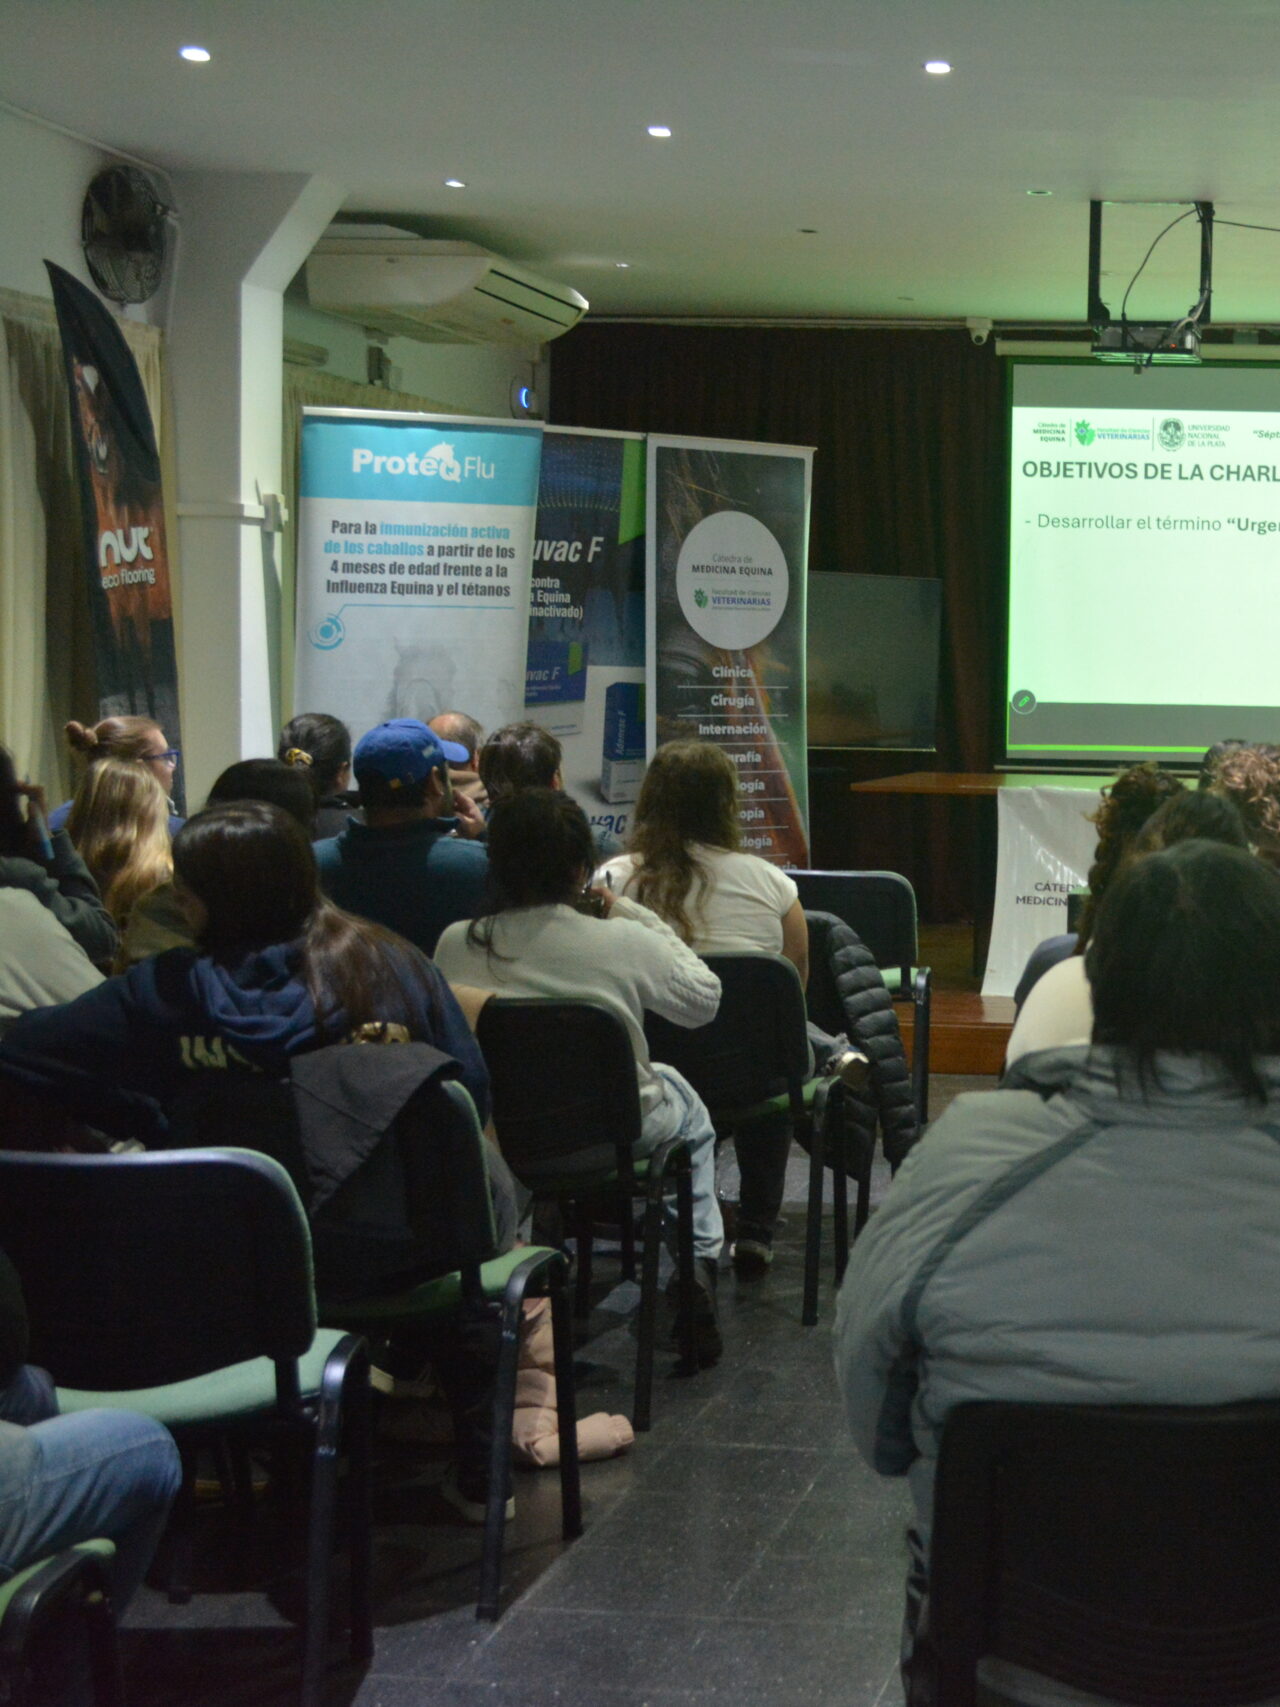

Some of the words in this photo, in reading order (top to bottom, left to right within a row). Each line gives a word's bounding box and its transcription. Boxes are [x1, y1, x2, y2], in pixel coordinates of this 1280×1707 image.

[1188, 424, 1230, 432] UNIVERSIDAD
[464, 456, 495, 479] Flu
[1022, 461, 1138, 479] OBJETIVOS
[1144, 463, 1172, 480] DE
[1178, 464, 1204, 480] LA
[331, 520, 361, 535] Para
[365, 521, 377, 535] la
[380, 521, 468, 538] inmunización
[471, 525, 510, 540] activa
[1038, 514, 1132, 529] Desarrollar
[1137, 516, 1151, 530] el
[1156, 517, 1222, 531] término
[324, 540, 340, 554] de
[344, 540, 364, 555] los
[367, 541, 424, 556] caballos
[427, 546, 434, 557] a
[437, 544, 475, 558] partir
[477, 545, 493, 558] de
[496, 546, 515, 559] los
[587, 537, 604, 563] F
[330, 560, 339, 574] 4
[342, 563, 386, 575] meses
[389, 562, 405, 575] de
[408, 562, 440, 576] edad
[443, 563, 482, 577] frente
[485, 566, 493, 577] a
[496, 564, 508, 578] la
[691, 564, 736, 575] MEDICINA
[739, 566, 774, 576] EQUINA
[102, 574, 120, 589] eco
[121, 567, 156, 584] flooring
[326, 579, 387, 594] Influenza
[390, 580, 434, 596] Equina
[436, 584, 444, 597] y
[446, 582, 459, 595] el
[461, 582, 511, 597] tétanos
[537, 590, 571, 604] Equina
[712, 597, 771, 606] VETERINARIAS
[712, 665, 753, 678] Clínica
[710, 693, 755, 709] Cirugía
[699, 722, 768, 735] Internación
